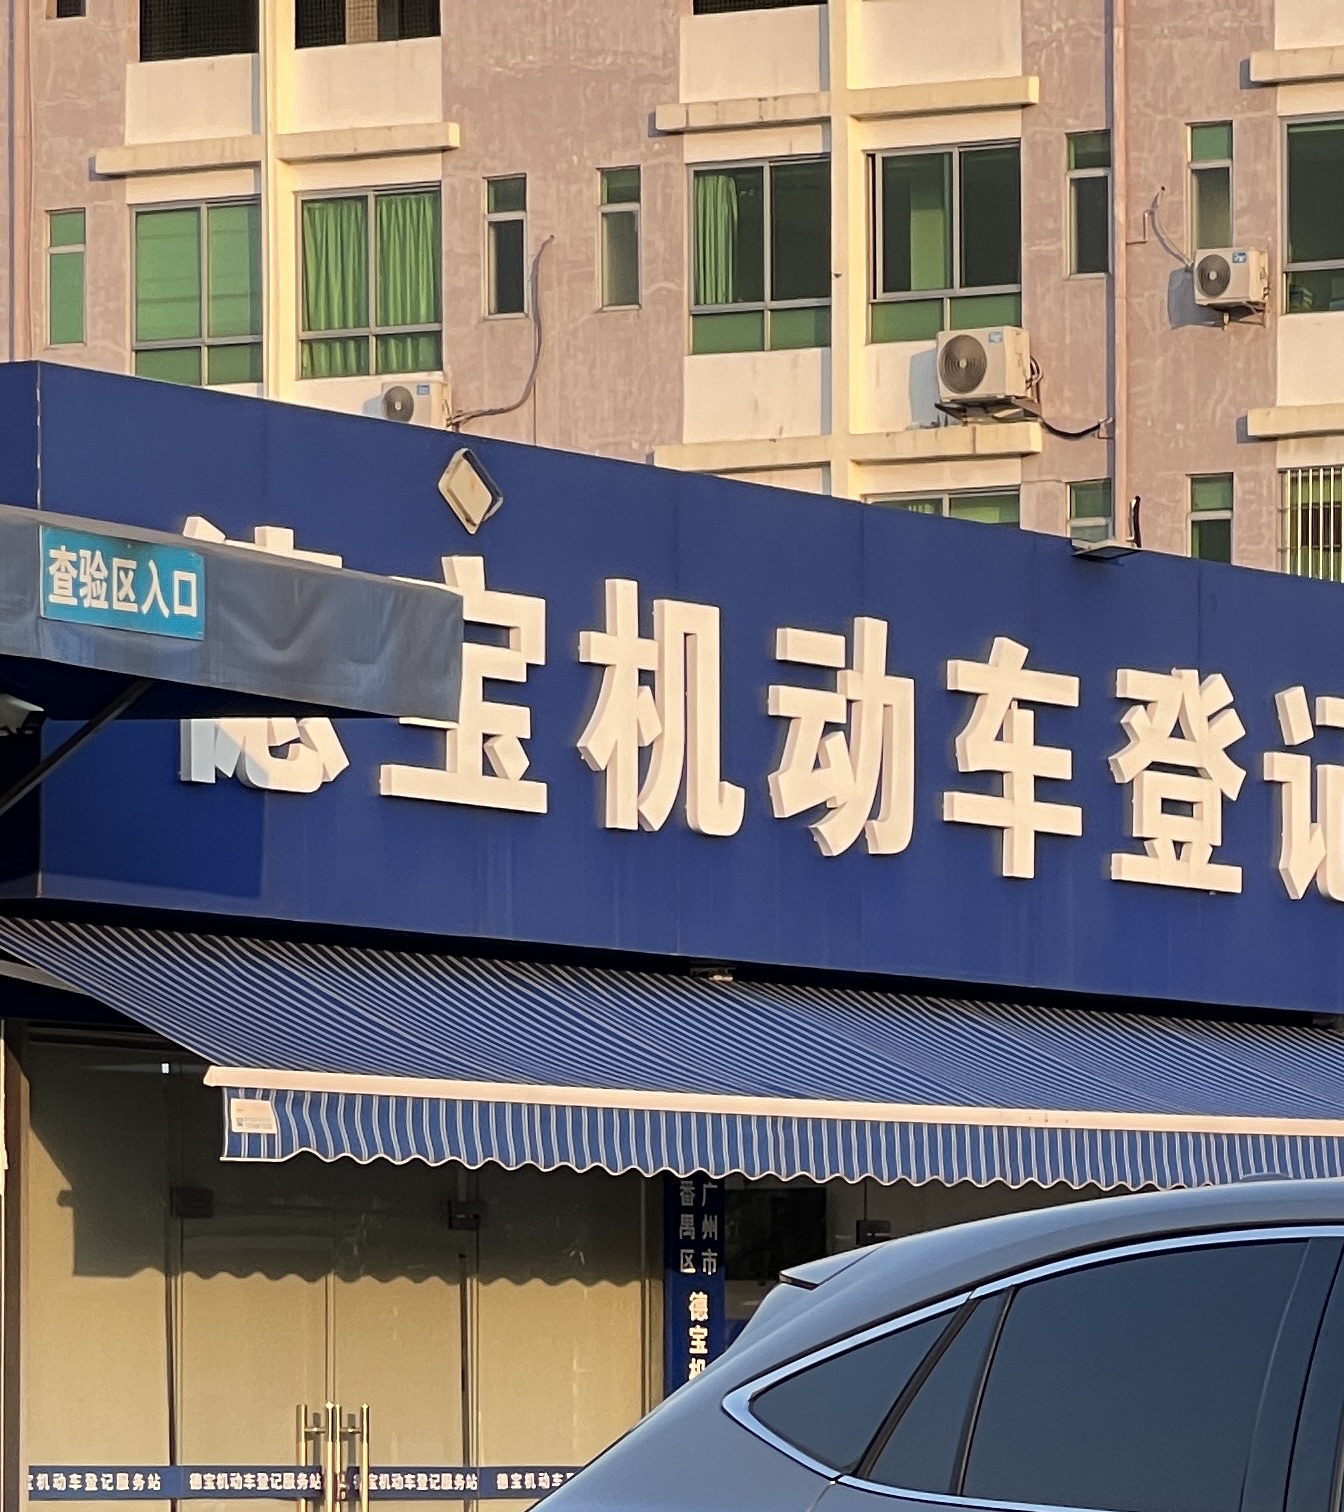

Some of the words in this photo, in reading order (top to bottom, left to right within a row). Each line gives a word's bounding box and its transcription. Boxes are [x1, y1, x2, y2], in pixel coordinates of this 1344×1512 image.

[48, 545, 197, 618] 查验区入口
[680, 1181, 696, 1274] 番禺区
[702, 1181, 718, 1275] 广州市
[497, 1472, 575, 1489] 德宝机动车
